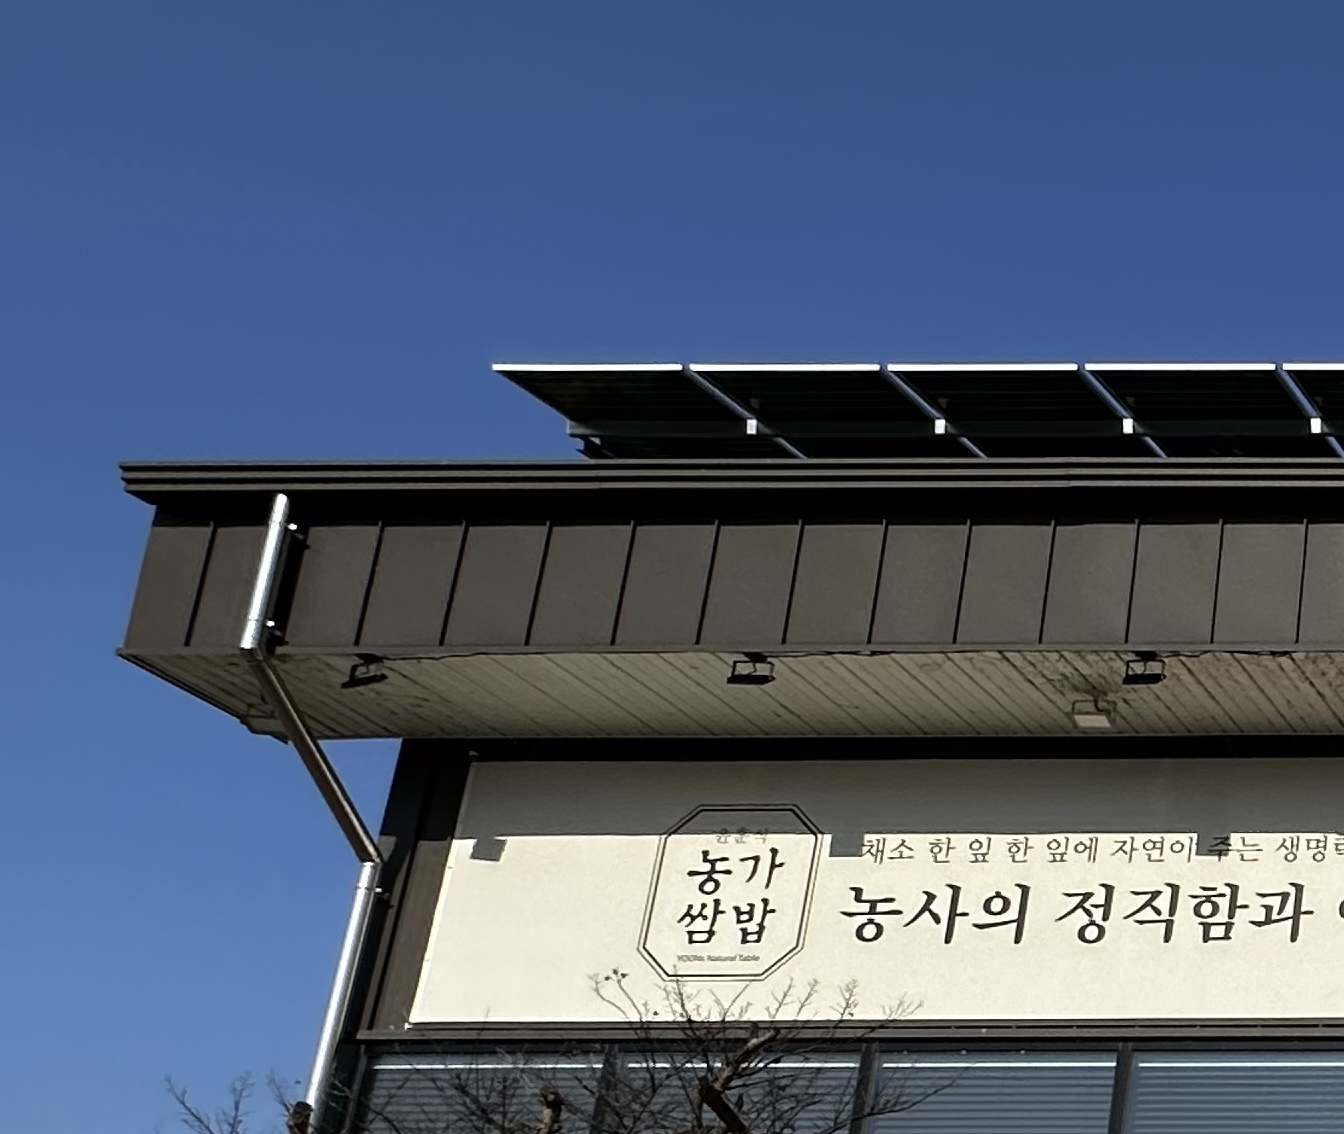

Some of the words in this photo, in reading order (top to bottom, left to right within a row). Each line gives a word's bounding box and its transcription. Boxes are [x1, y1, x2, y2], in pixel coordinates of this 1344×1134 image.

[687, 847, 786, 895] 농가
[861, 836, 915, 864] 채소
[929, 836, 956, 864] 한
[969, 836, 991, 864] 잎
[1007, 836, 1034, 864] 한
[1047, 835, 1098, 863] 잎에
[1113, 835, 1193, 863] 자연이
[1208, 835, 1264, 863] 주는
[676, 898, 777, 945] 쌈밥
[840, 883, 1032, 944] 농사의
[1054, 882, 1314, 943] 정직함과
